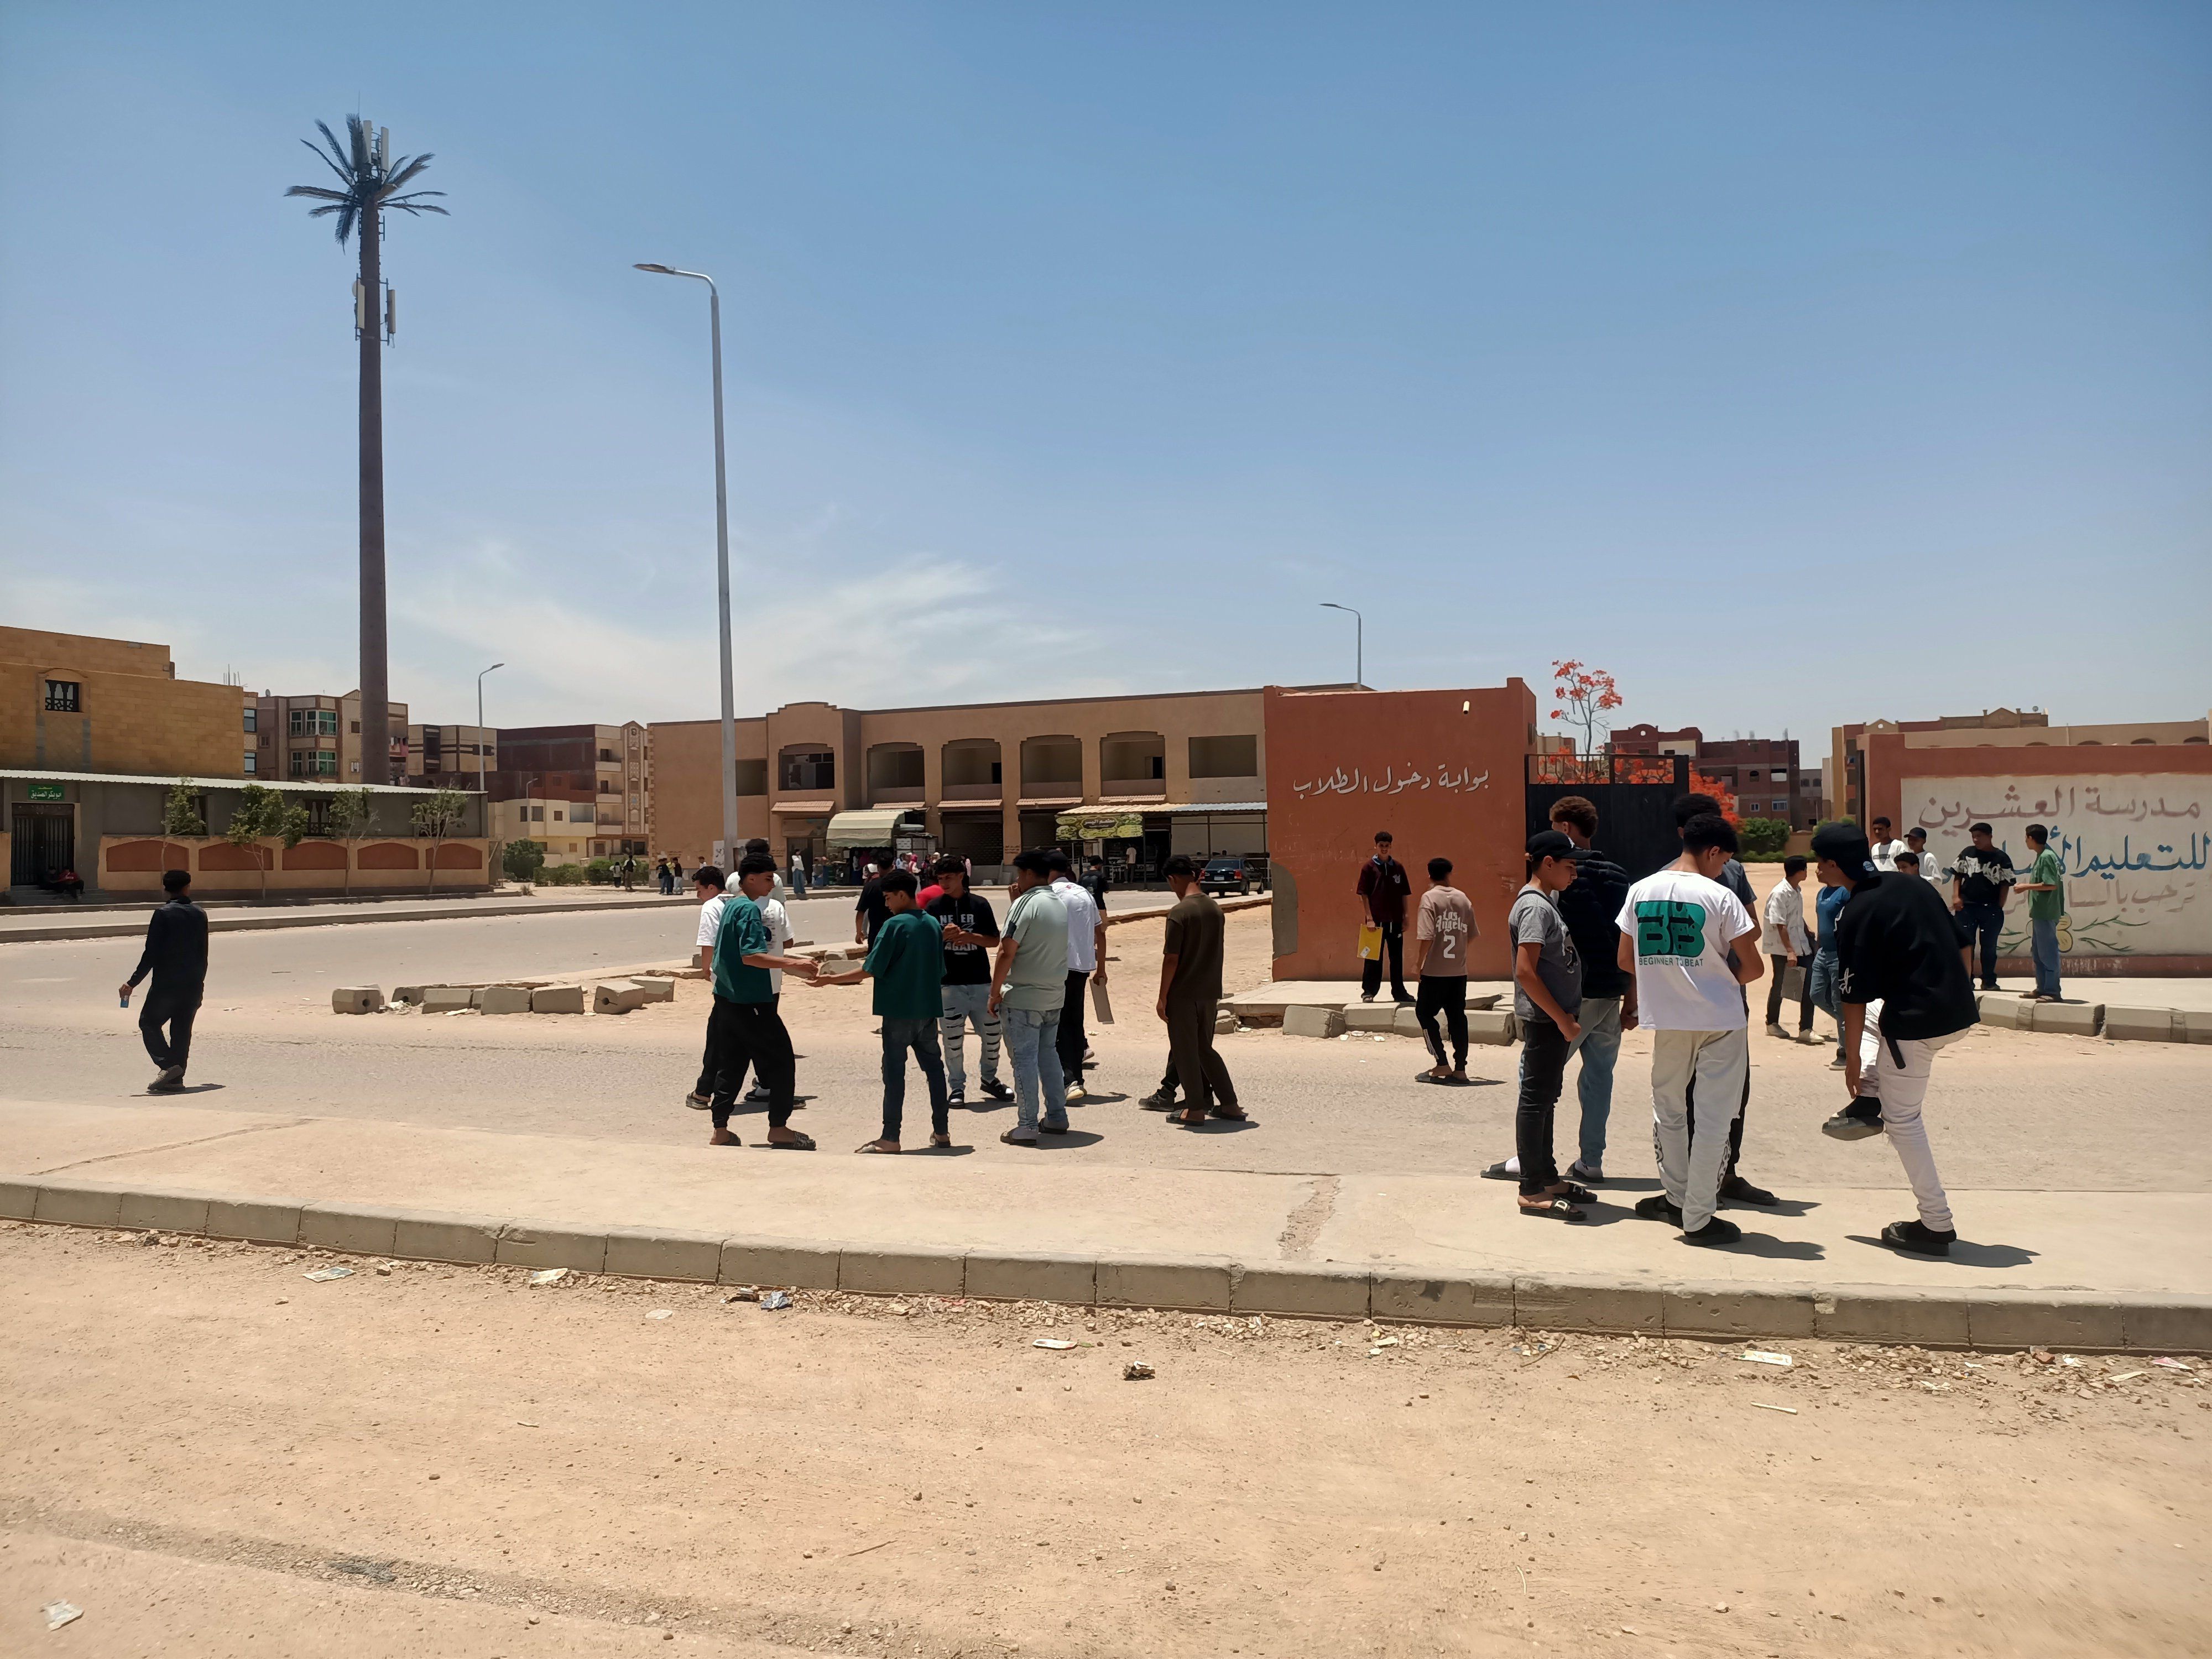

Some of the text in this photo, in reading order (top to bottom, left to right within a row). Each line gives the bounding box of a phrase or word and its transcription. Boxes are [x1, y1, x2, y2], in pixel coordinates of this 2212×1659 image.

[1293, 762, 1489, 799] بوابة دخول الطلاب
[1918, 784, 2200, 837] مدرسة العشرين
[2070, 831, 2211, 880] للتعليم
[1443, 935, 1455, 958] 2
[1639, 957, 1673, 966] BEGINNER
[1684, 958, 1703, 967] BEAT
